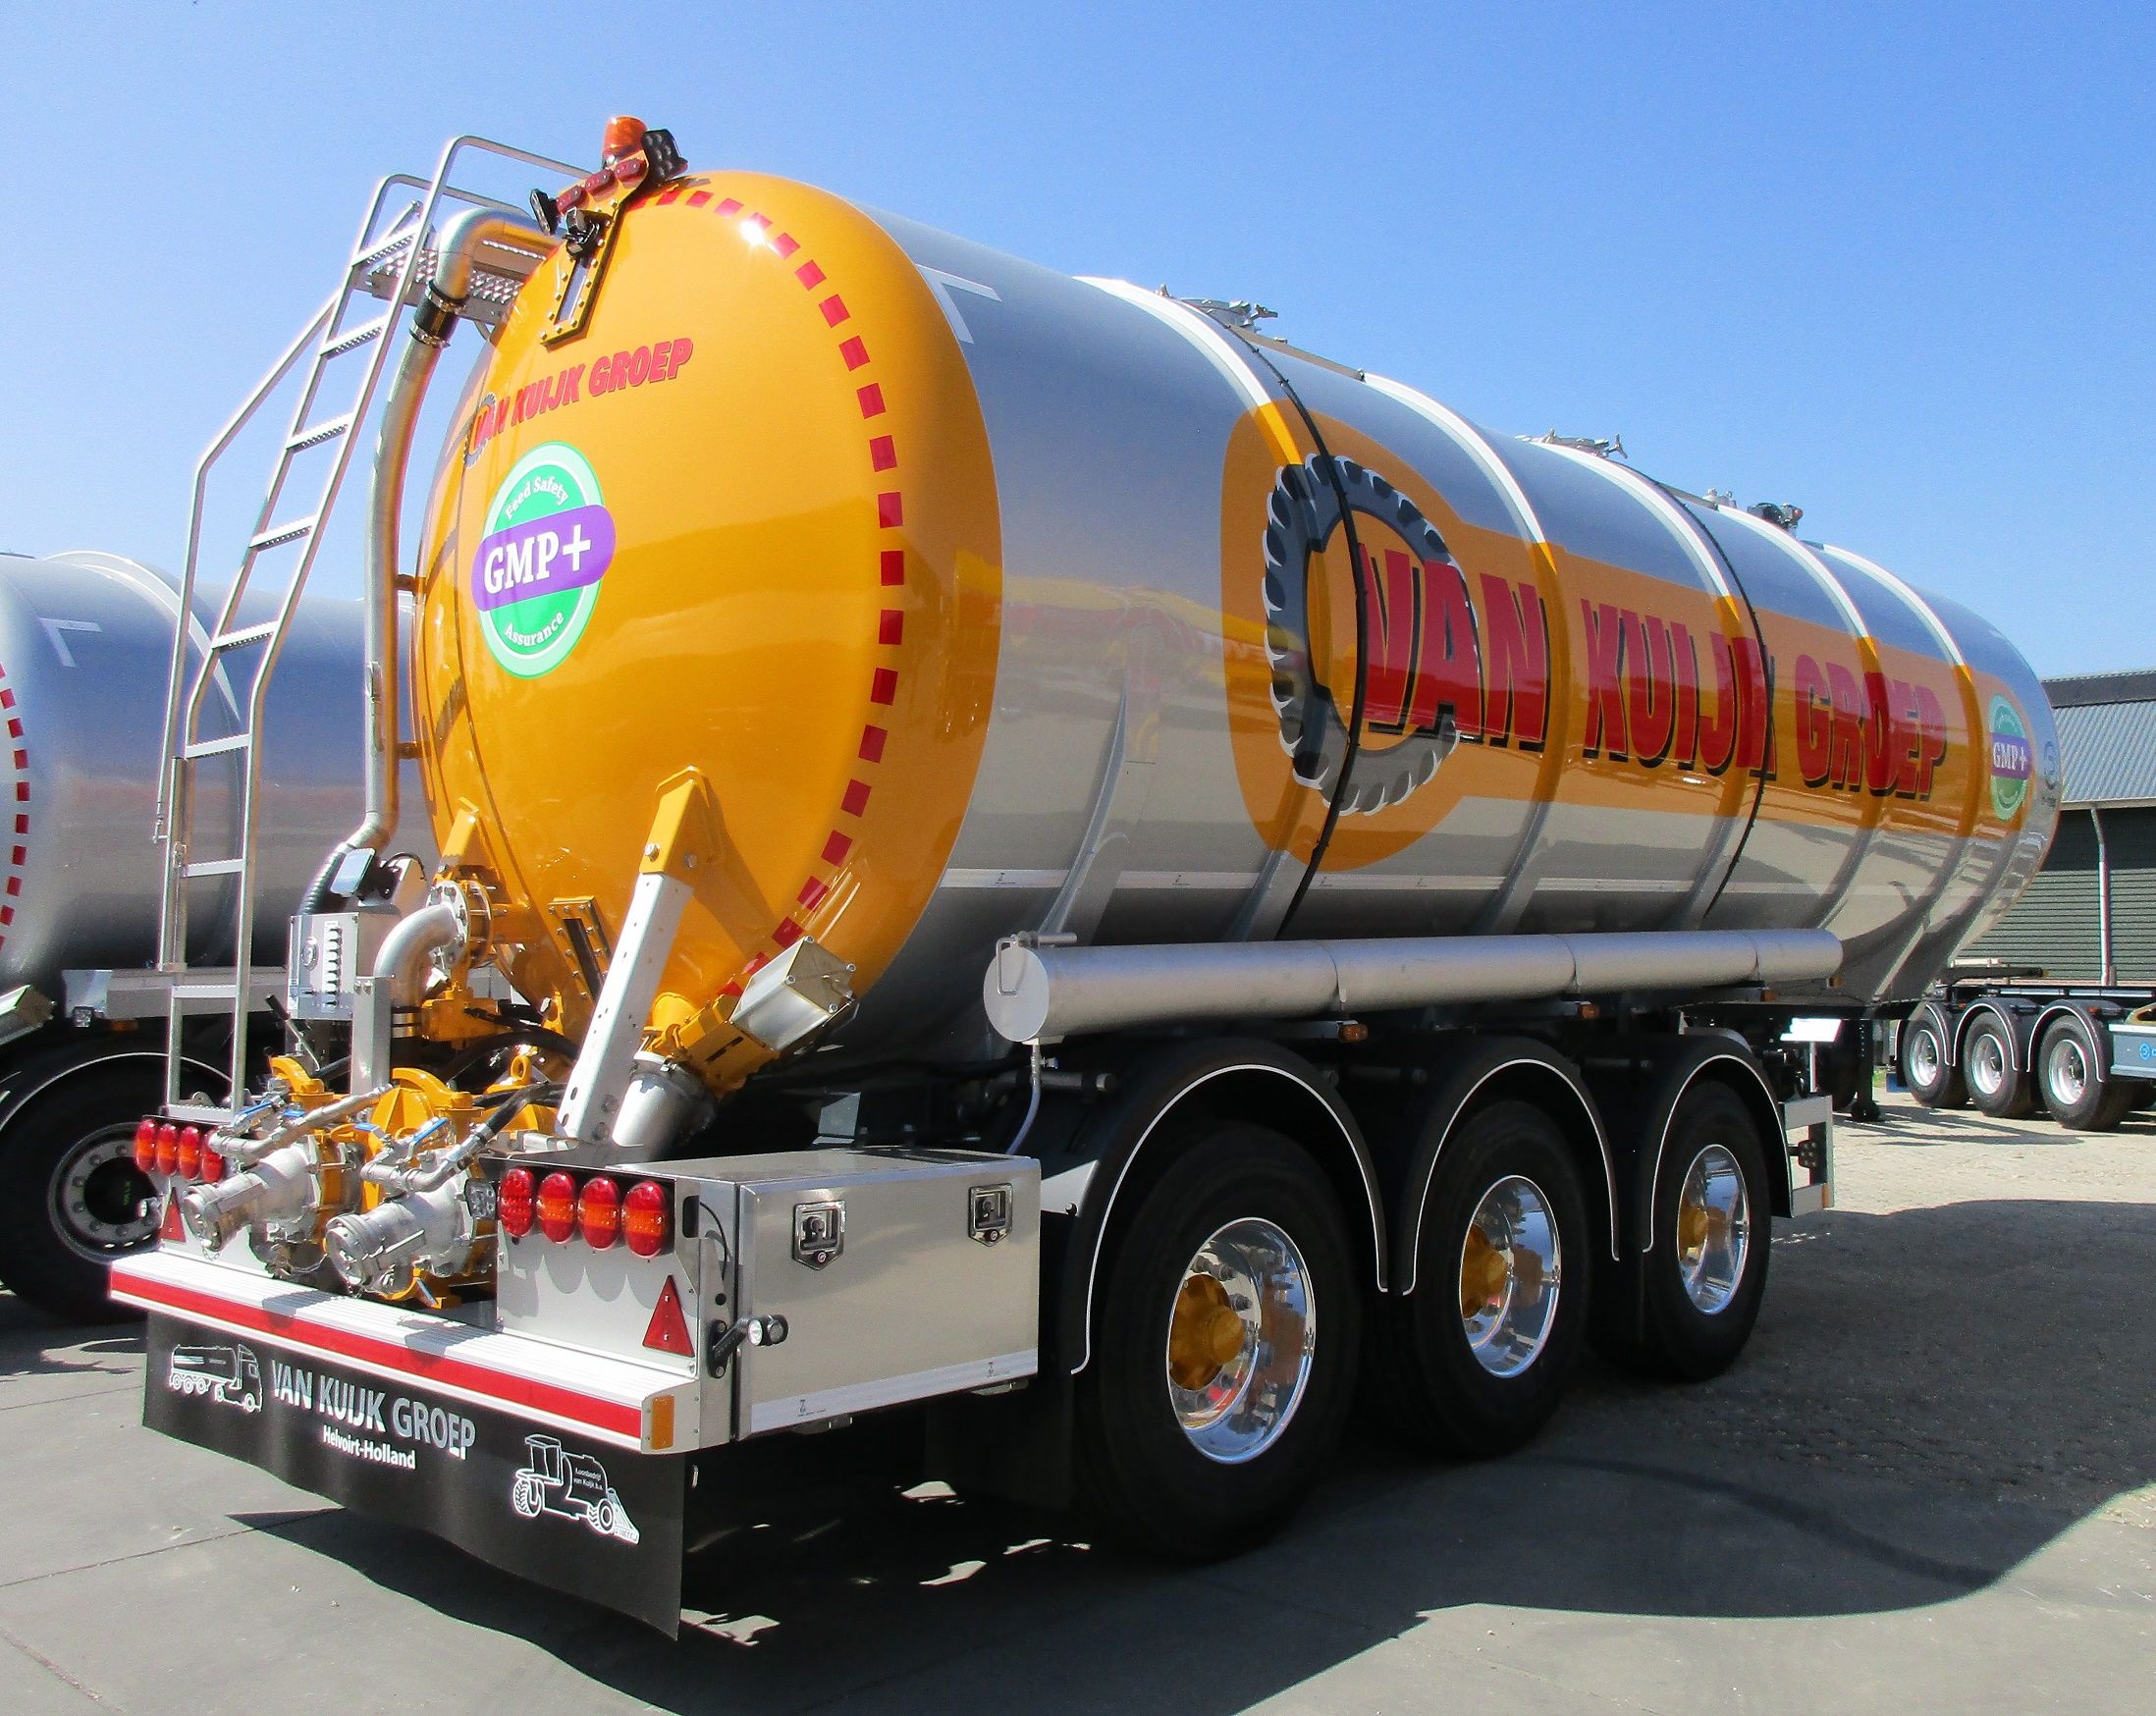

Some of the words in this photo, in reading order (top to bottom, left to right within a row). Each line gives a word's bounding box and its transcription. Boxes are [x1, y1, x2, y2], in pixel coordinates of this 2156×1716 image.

[511, 363, 585, 427] KUIJK
[589, 338, 693, 397] GROEP
[504, 480, 531, 520] Feed
[533, 475, 569, 507] Safety
[484, 523, 591, 594] GMP+
[504, 612, 565, 647] Assurance
[1358, 542, 1552, 752] VAN
[1580, 598, 1777, 781] KUIJK
[1795, 654, 1948, 801] GROEP
[1993, 741, 2027, 772] GMP+
[271, 1360, 313, 1410] VAN
[318, 1374, 387, 1432] KUIJK
[393, 1397, 476, 1460] GROEP
[323, 1424, 416, 1470] Helvoirt-Holland
